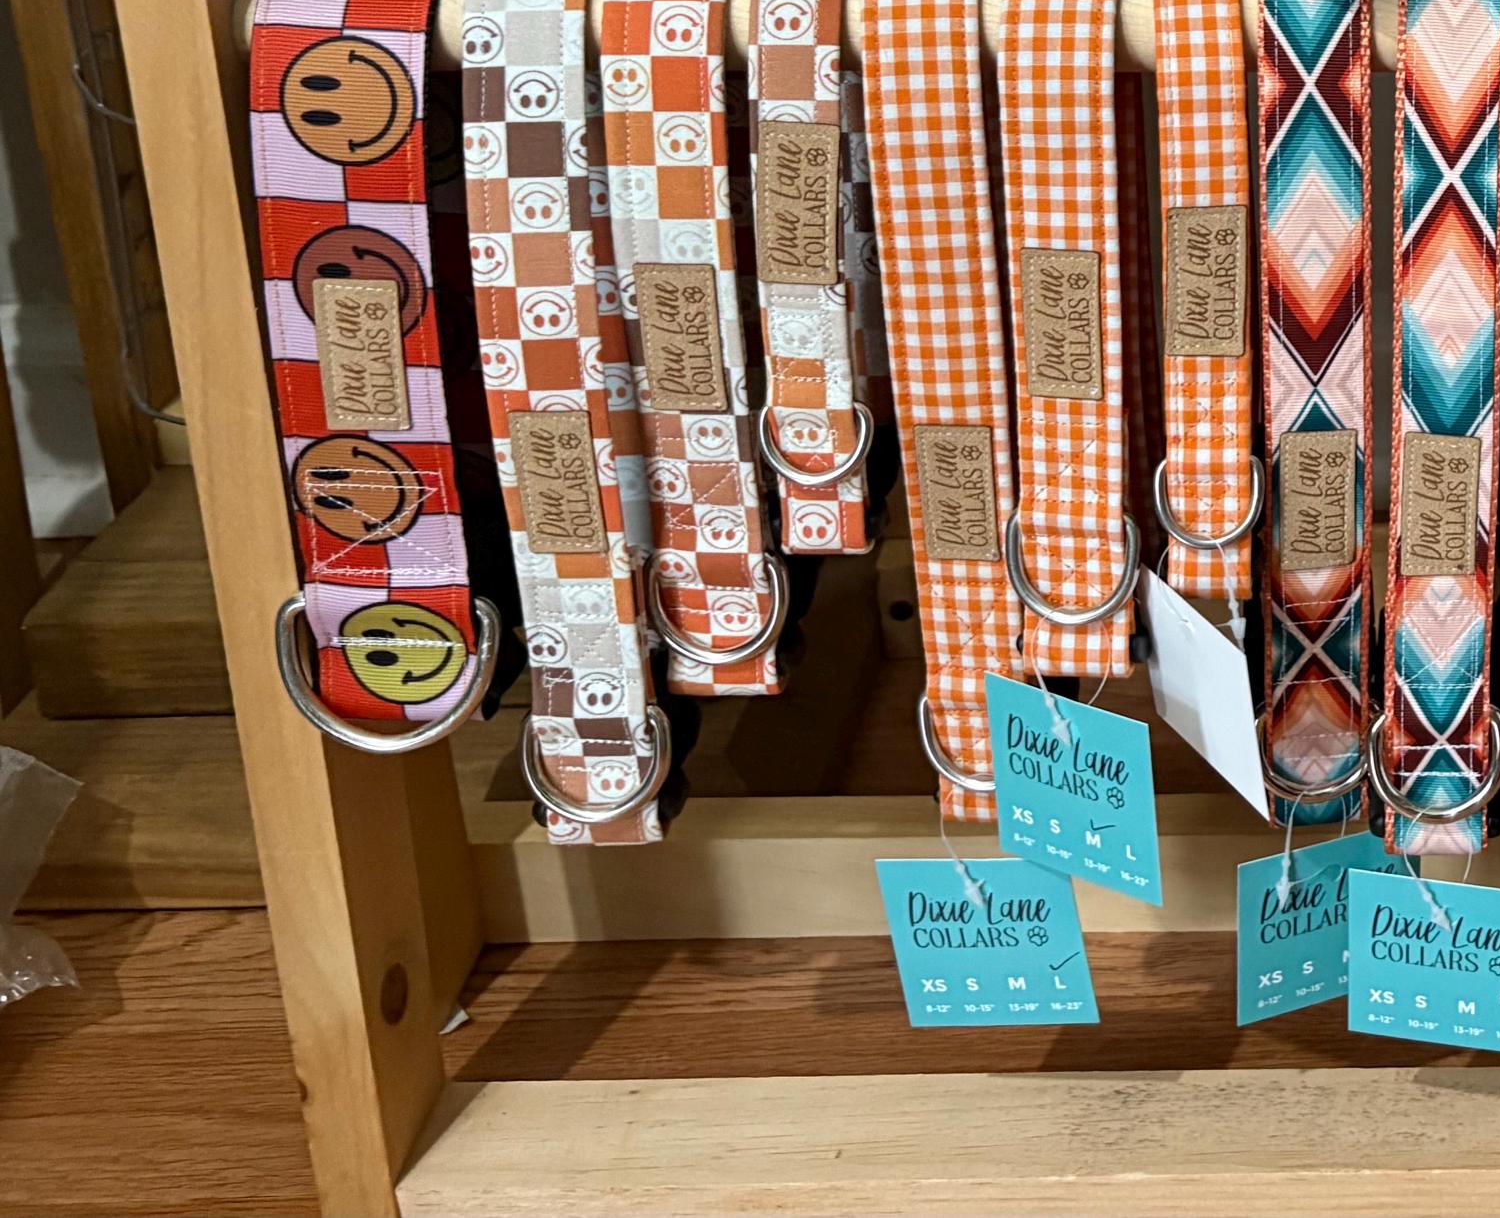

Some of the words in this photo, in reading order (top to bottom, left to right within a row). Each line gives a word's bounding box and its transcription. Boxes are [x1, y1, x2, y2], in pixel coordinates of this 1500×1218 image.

[768, 139, 803, 200] Lane
[767, 209, 801, 268] Dixie
[801, 175, 828, 270] COLLARS
[1177, 223, 1213, 278] Lane
[653, 279, 684, 336] Lane
[1034, 265, 1066, 320] Lane
[1176, 287, 1211, 340] Dixie
[1212, 251, 1237, 341] COLLARS
[331, 296, 366, 352] Lane
[1067, 295, 1093, 384] COLLARS
[366, 327, 397, 415] COLLARS
[657, 343, 690, 396] Dixie
[683, 309, 716, 398] COLLARS
[1037, 330, 1069, 382] Dixie
[337, 361, 373, 415] Dixie
[524, 426, 562, 481] Lane
[928, 437, 961, 490] Lane
[1293, 447, 1324, 498] Lane
[1413, 449, 1446, 503] Lane
[536, 487, 572, 539] Dixie
[562, 456, 595, 540] COLLARS
[935, 499, 966, 546] Dixie
[962, 466, 988, 548] COLLARS
[1323, 471, 1346, 555] COLLARS
[1444, 479, 1468, 563] COLLARS
[1289, 506, 1320, 555] Dixie
[1409, 510, 1444, 562] Dixie
[1007, 713, 1064, 763] Dixie
[1073, 737, 1130, 786] Lane
[1009, 752, 1099, 802] COLLARS
[1012, 805, 1034, 825] XS
[1050, 819, 1061, 834] S
[1085, 831, 1101, 848] M
[1126, 844, 1137, 861] L
[908, 891, 974, 927] Dixie
[986, 892, 1051, 925] Lane
[1260, 903, 1348, 944] COLLAR
[1371, 904, 1440, 944] Dixie
[913, 926, 1020, 949] COLLARS
[1371, 940, 1479, 972] COLLARS
[921, 979, 948, 993] XS
[966, 978, 979, 991] S
[1008, 977, 1026, 990] M
[1054, 976, 1067, 989] L
[1258, 970, 1283, 988] XS
[1302, 961, 1314, 974] S
[1369, 989, 1395, 1004] XS
[1415, 995, 1428, 1008] S
[1458, 1000, 1476, 1015] M
